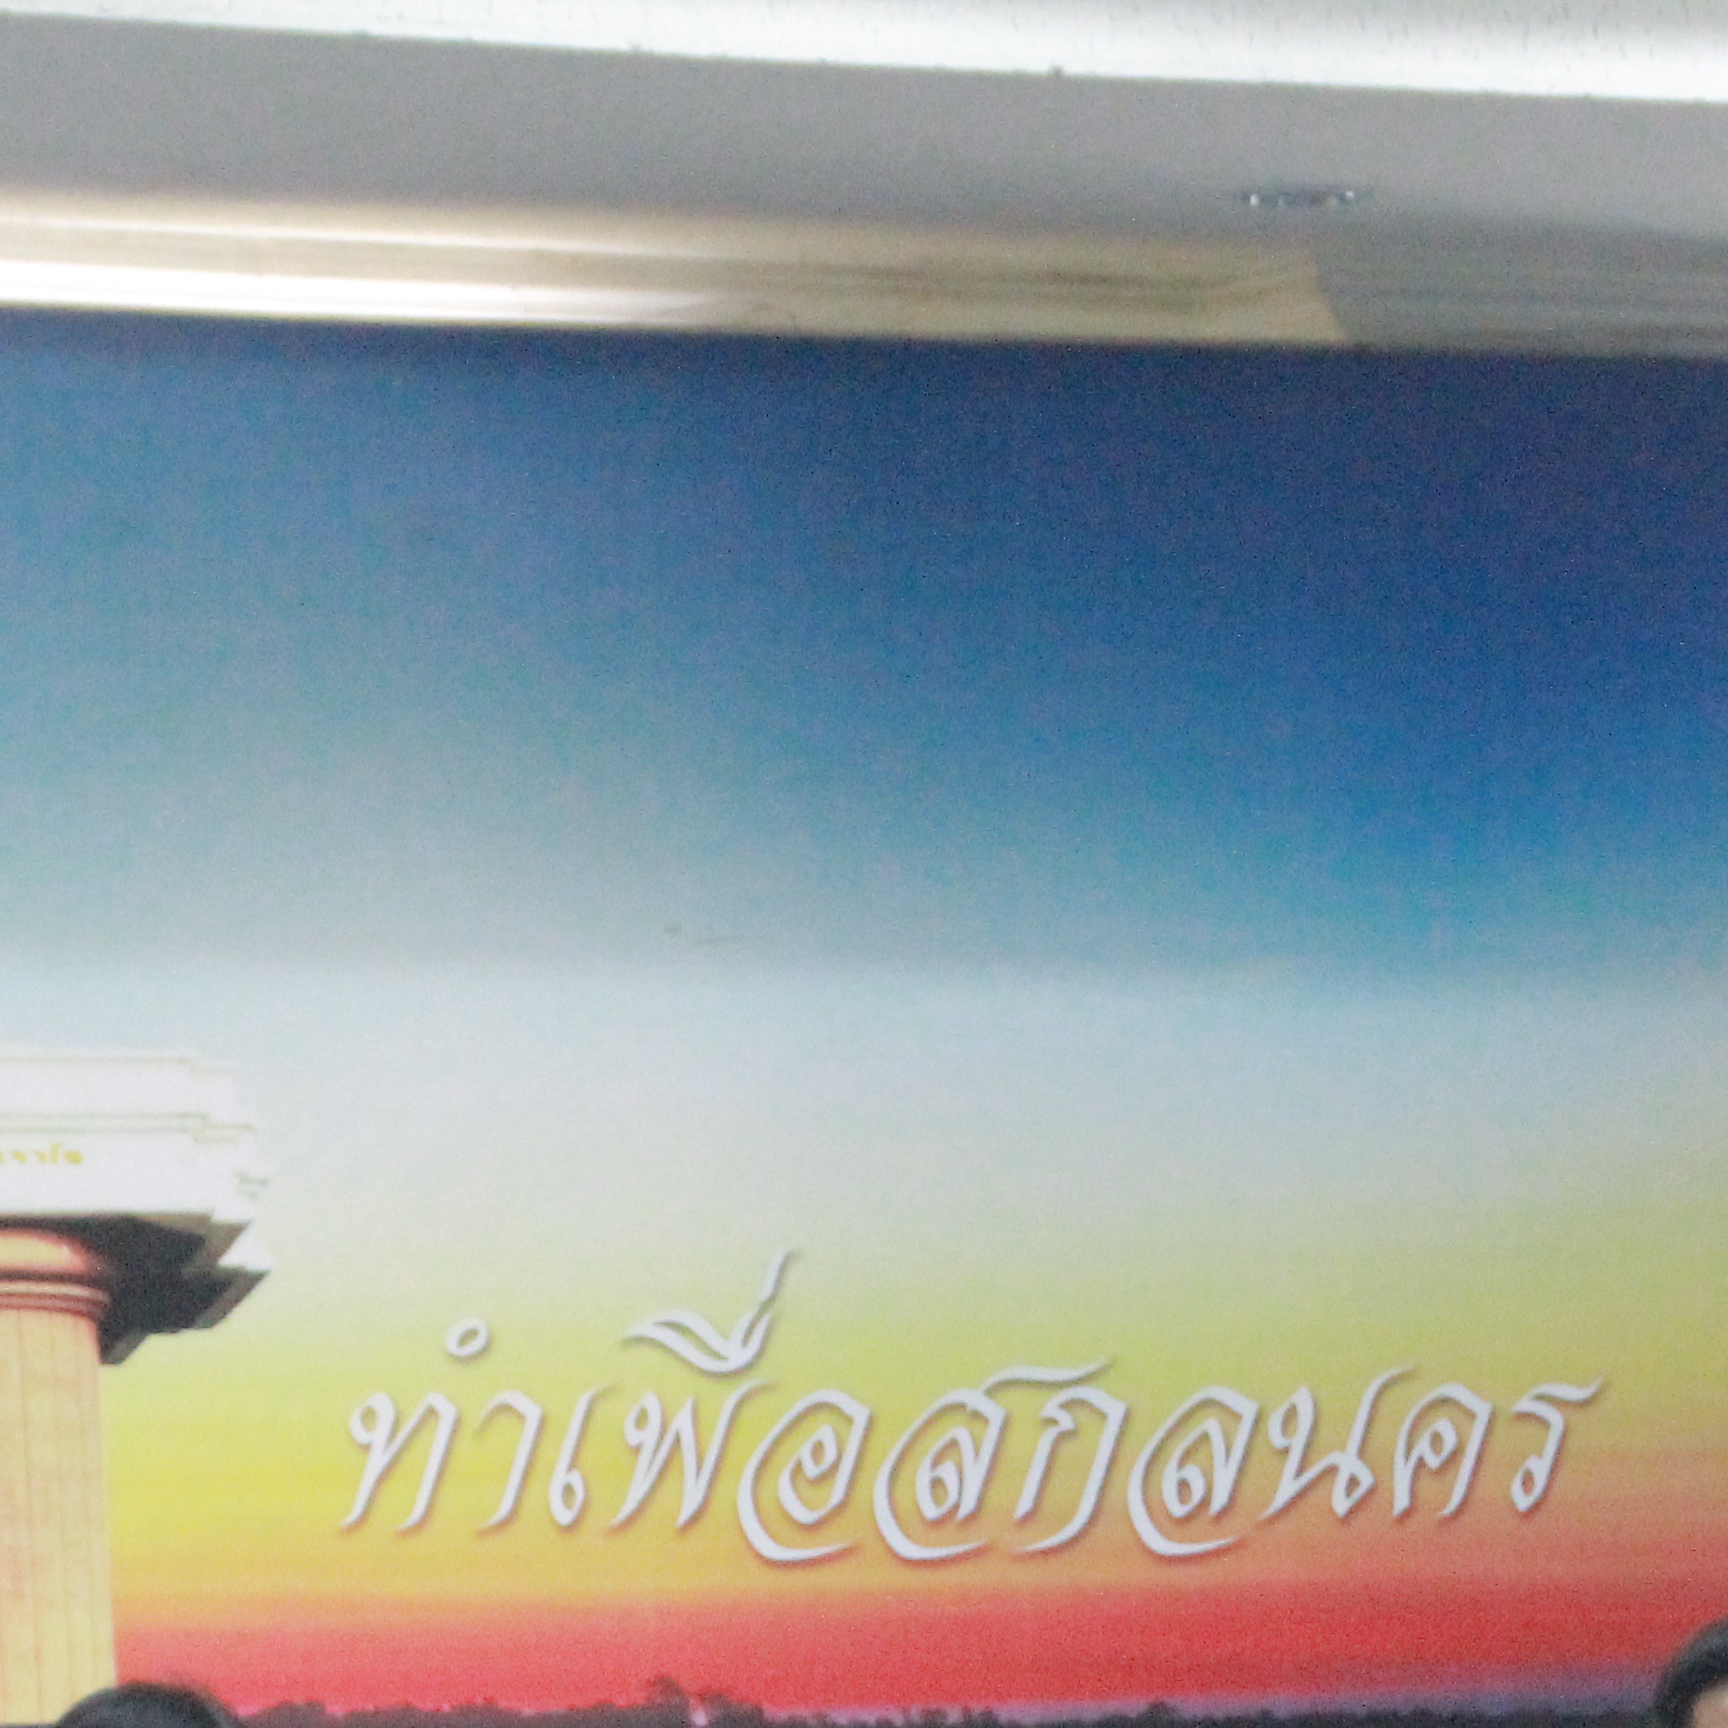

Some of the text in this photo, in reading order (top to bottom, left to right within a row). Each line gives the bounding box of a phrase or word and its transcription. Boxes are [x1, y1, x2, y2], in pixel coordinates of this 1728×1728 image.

[338, 1248, 1606, 1562] ทำเพื่อสกลนคร
